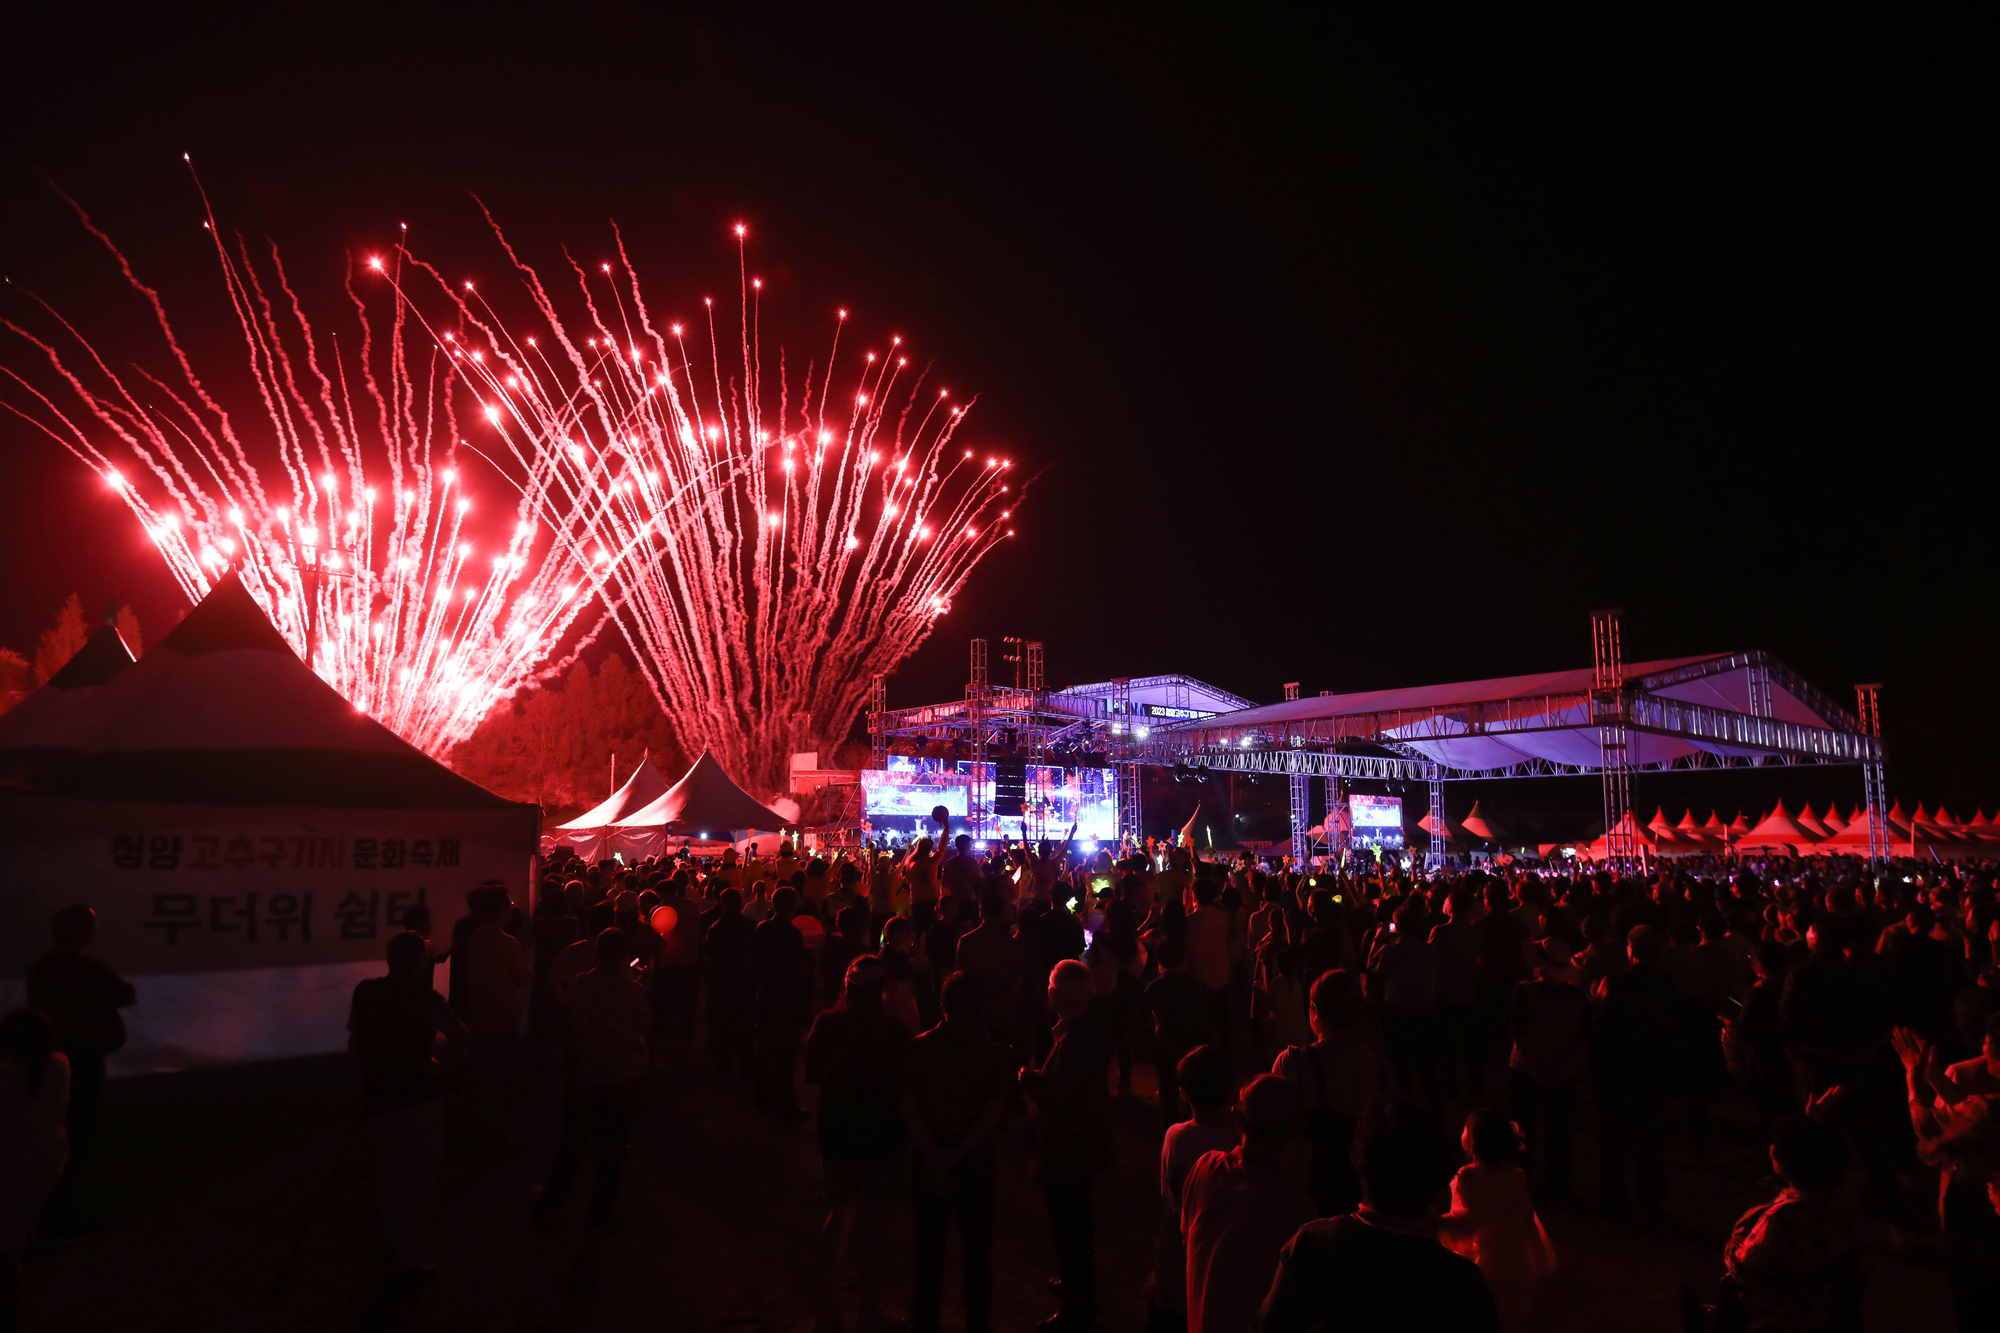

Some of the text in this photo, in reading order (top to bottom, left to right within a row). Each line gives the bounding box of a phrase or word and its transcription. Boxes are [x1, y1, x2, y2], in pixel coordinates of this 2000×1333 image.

[1151, 706, 1165, 716] 2023
[111, 834, 460, 870] 청양 고추구기자 문화축제
[144, 887, 427, 946] 무더위 쉼터
